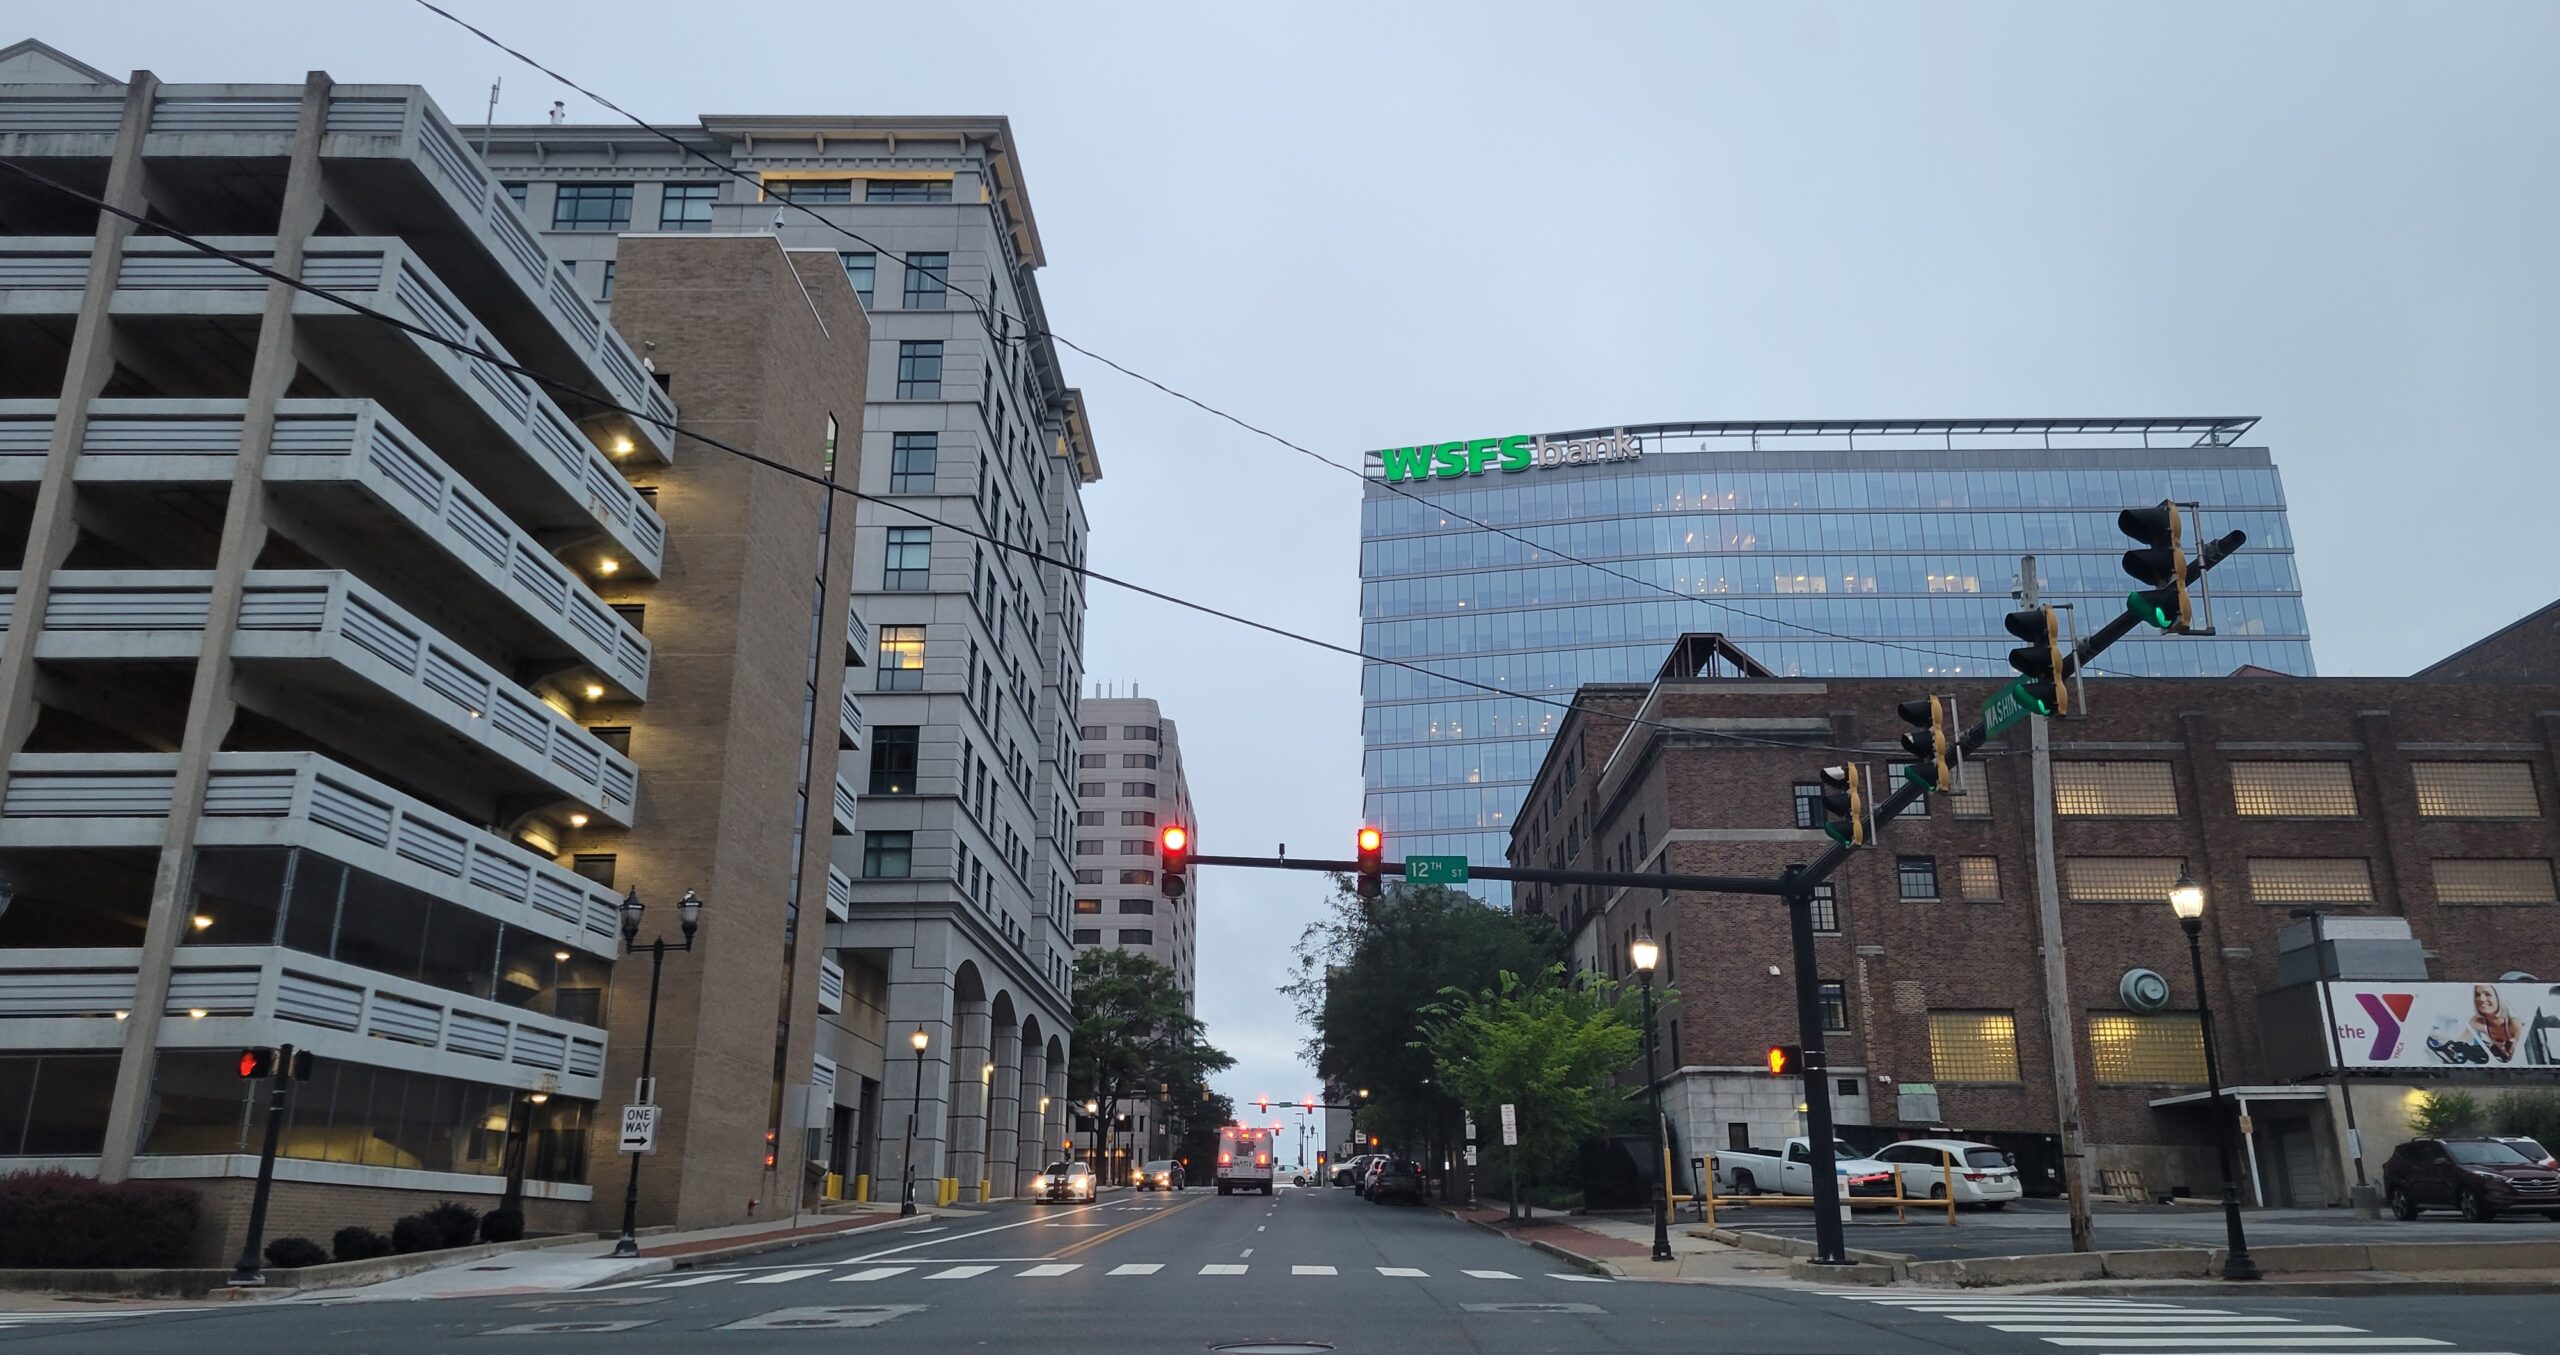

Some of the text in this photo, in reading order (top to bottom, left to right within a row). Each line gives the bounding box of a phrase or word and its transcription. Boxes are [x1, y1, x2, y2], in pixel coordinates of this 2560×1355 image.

[1381, 427, 1641, 483] WSFS bank
[1412, 861, 1462, 878] 12TH ST
[2338, 1024, 2366, 1039] the
[627, 1109, 651, 1120] ONE
[625, 1122, 650, 1133] WAY
